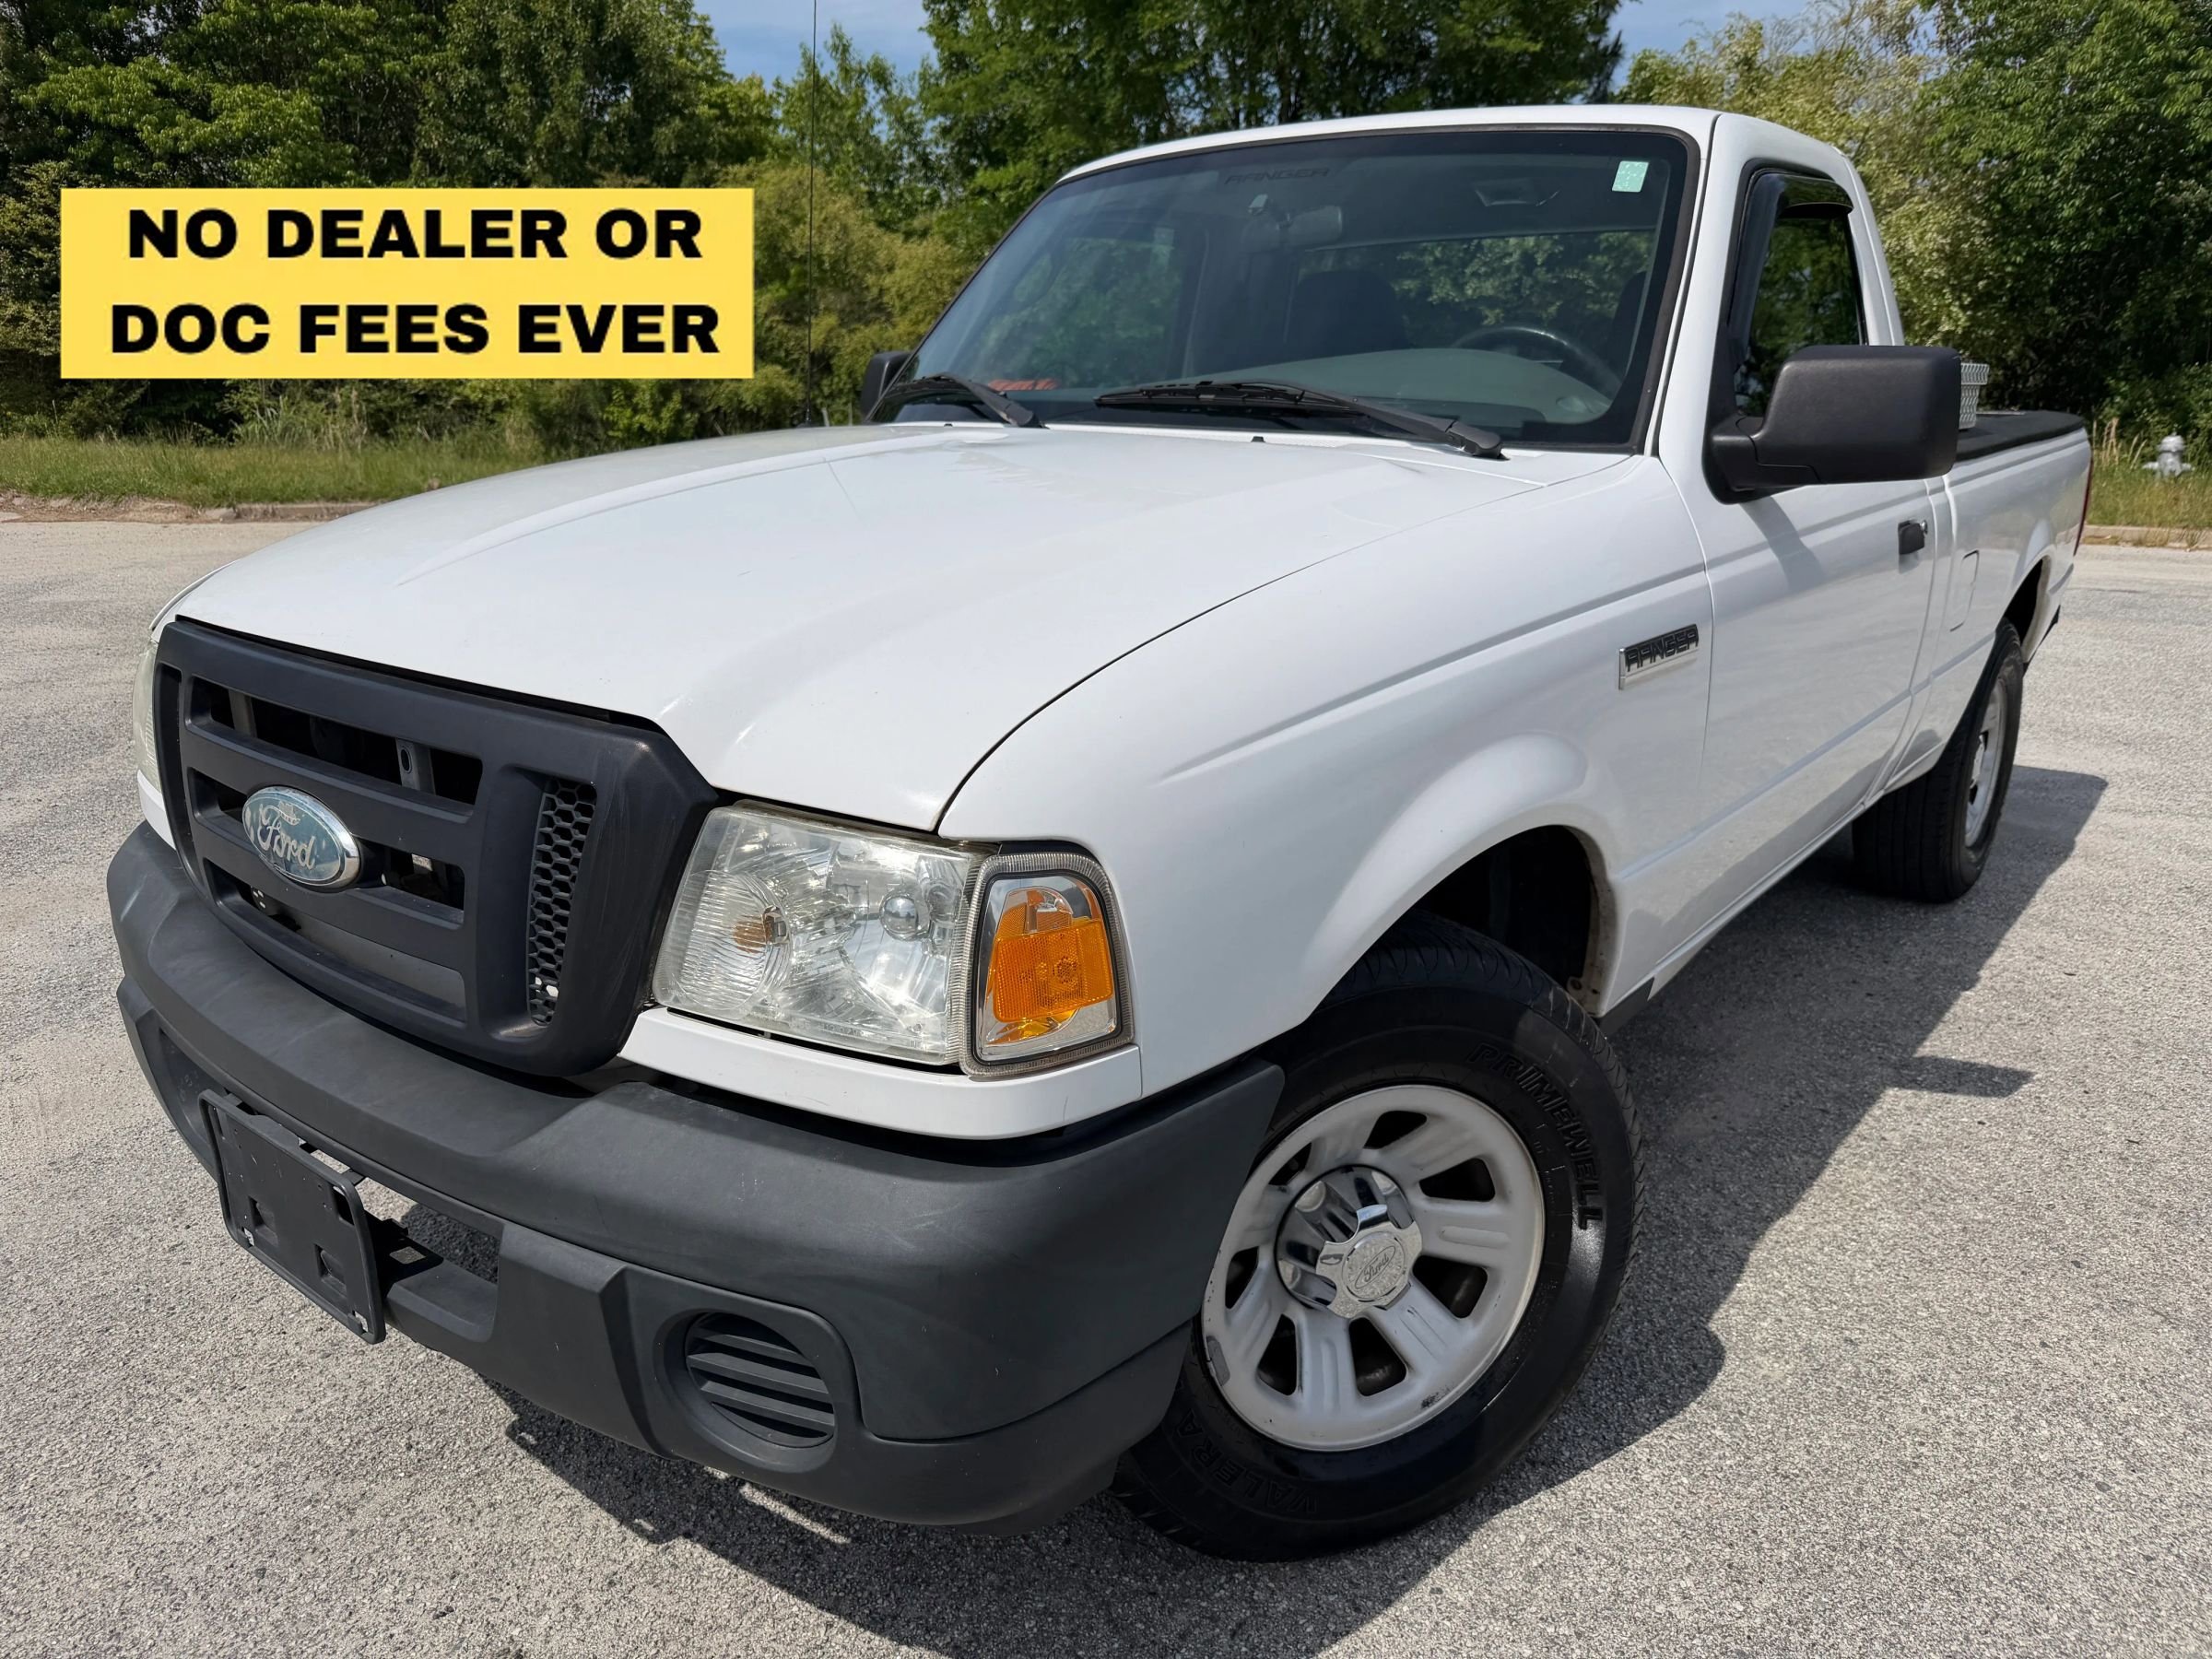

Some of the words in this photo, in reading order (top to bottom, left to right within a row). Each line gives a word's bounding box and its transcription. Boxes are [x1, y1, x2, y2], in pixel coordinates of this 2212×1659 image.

[1224, 167, 1331, 185] RANGER
[1625, 626, 1699, 673] RANGER
[257, 803, 316, 870] Ford
[1466, 1042, 1604, 1230] PRIMEWELL
[1363, 1253, 1391, 1283] Ford
[1175, 1407, 1319, 1513] VALERA
